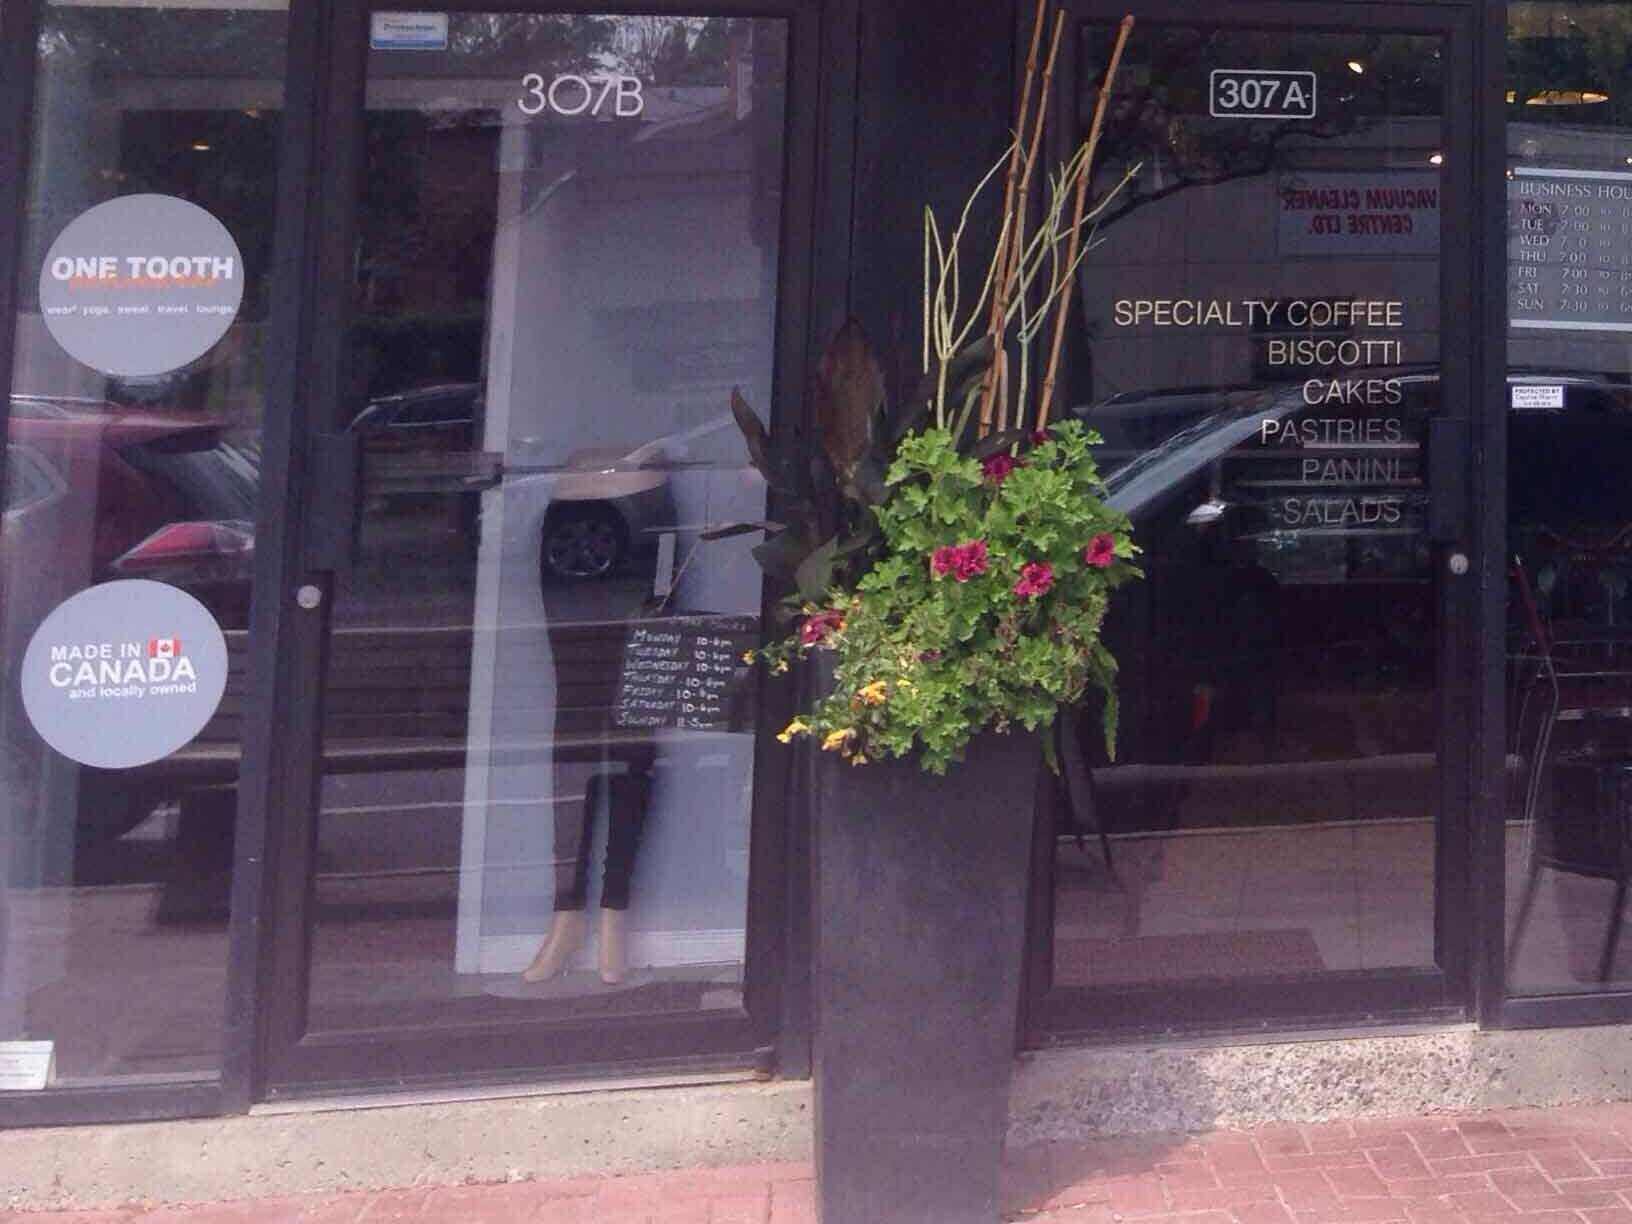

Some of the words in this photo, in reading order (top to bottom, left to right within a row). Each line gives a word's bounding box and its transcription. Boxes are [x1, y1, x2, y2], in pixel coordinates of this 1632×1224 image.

[517, 73, 644, 117] 307B
[1218, 79, 1307, 109] 307A
[1520, 182, 1592, 196] BUSINESS
[1521, 219, 1543, 230] TUE
[1520, 235, 1549, 246] WED
[51, 256, 117, 280] ONE
[126, 256, 234, 280] TOOTH
[1520, 250, 1546, 262] THU
[1518, 266, 1537, 278] FRI
[1114, 300, 1279, 327] SPECIALTY
[1287, 301, 1403, 327] COFFEE
[1269, 340, 1401, 366] BISCOTTI
[1303, 378, 1402, 406] CAKES
[1262, 418, 1401, 446] PASTRIES
[1302, 459, 1401, 484] PANINI
[1282, 498, 1401, 524] SALADS
[51, 644, 112, 661] MADE
[120, 643, 142, 658] IN
[49, 656, 197, 688] CANADA
[69, 687, 97, 699] and
[100, 684, 147, 698] locally
[149, 682, 197, 696] owned
